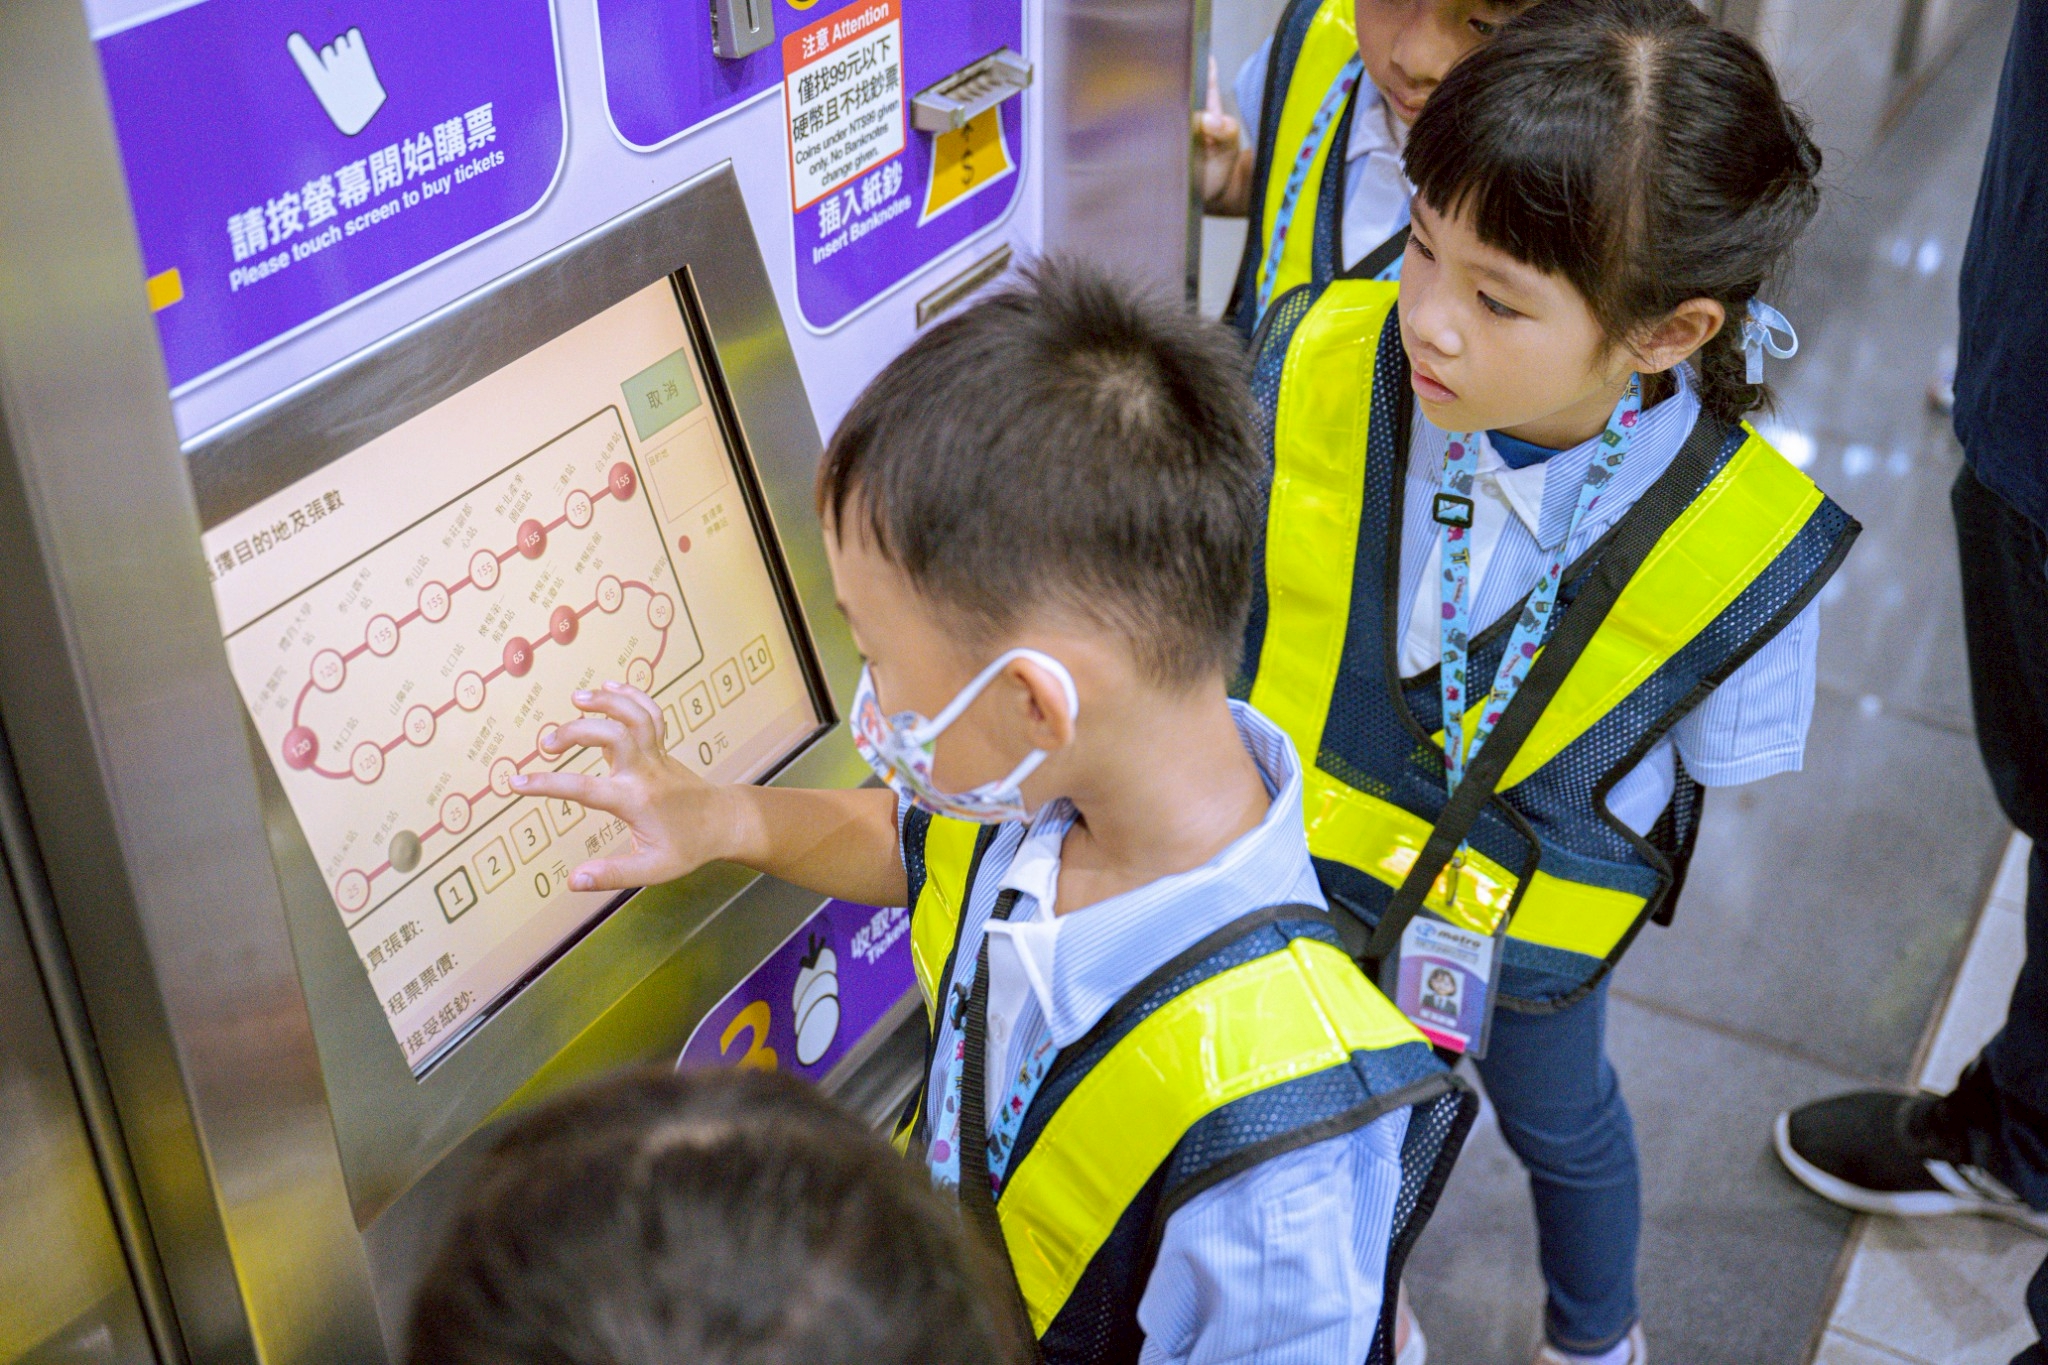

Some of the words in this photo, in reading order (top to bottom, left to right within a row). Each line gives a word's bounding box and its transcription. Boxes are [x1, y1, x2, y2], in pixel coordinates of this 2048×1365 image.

[802, 27, 829, 59] 注意
[832, 2, 889, 46] Attention
[798, 35, 892, 106] 僅找99元以下
[793, 63, 900, 143] 硬幣且不找鈔票
[795, 142, 822, 165] Coins
[823, 129, 849, 151] under
[875, 100, 900, 121] given
[830, 150, 844, 167] No
[844, 123, 889, 157] Banknotes
[227, 102, 497, 263] 請按螢幕開始購票
[821, 163, 849, 187] change
[819, 159, 903, 239] 插入紙鈔
[229, 249, 290, 292] Please
[291, 225, 342, 262] touch
[345, 199, 401, 237] screen
[403, 189, 420, 208] to
[422, 173, 453, 201] buy
[454, 150, 505, 185] tickets
[812, 236, 850, 265] Insert
[850, 195, 912, 242] Banknotes
[646, 379, 680, 410] 取消
[615, 473, 631, 489] 155
[572, 501, 587, 518] 155
[208, 489, 345, 581] 擇目的地及張數
[523, 531, 541, 548] 155
[476, 561, 494, 579] 155
[426, 593, 445, 611] 155
[604, 587, 616, 602] 65
[655, 605, 667, 619] 50
[559, 619, 571, 633] 65
[374, 627, 393, 645] 155
[512, 650, 526, 665] 65
[635, 671, 647, 683] 40
[464, 685, 477, 698] 70
[413, 719, 427, 733] 80
[292, 739, 313, 758] 120
[358, 754, 378, 772] 120
[449, 886, 465, 905] 1
[486, 855, 502, 876] 2
[524, 828, 537, 847] 3
[560, 800, 573, 817] 4
[691, 698, 703, 716] 8
[722, 674, 734, 692] 9
[747, 647, 767, 673] 10
[449, 807, 463, 822] 25
[382, 952, 459, 1019] 程票票價:
[534, 872, 551, 899] 0
[551, 858, 569, 886] 元
[698, 741, 713, 766] 0
[713, 731, 730, 754] 元
